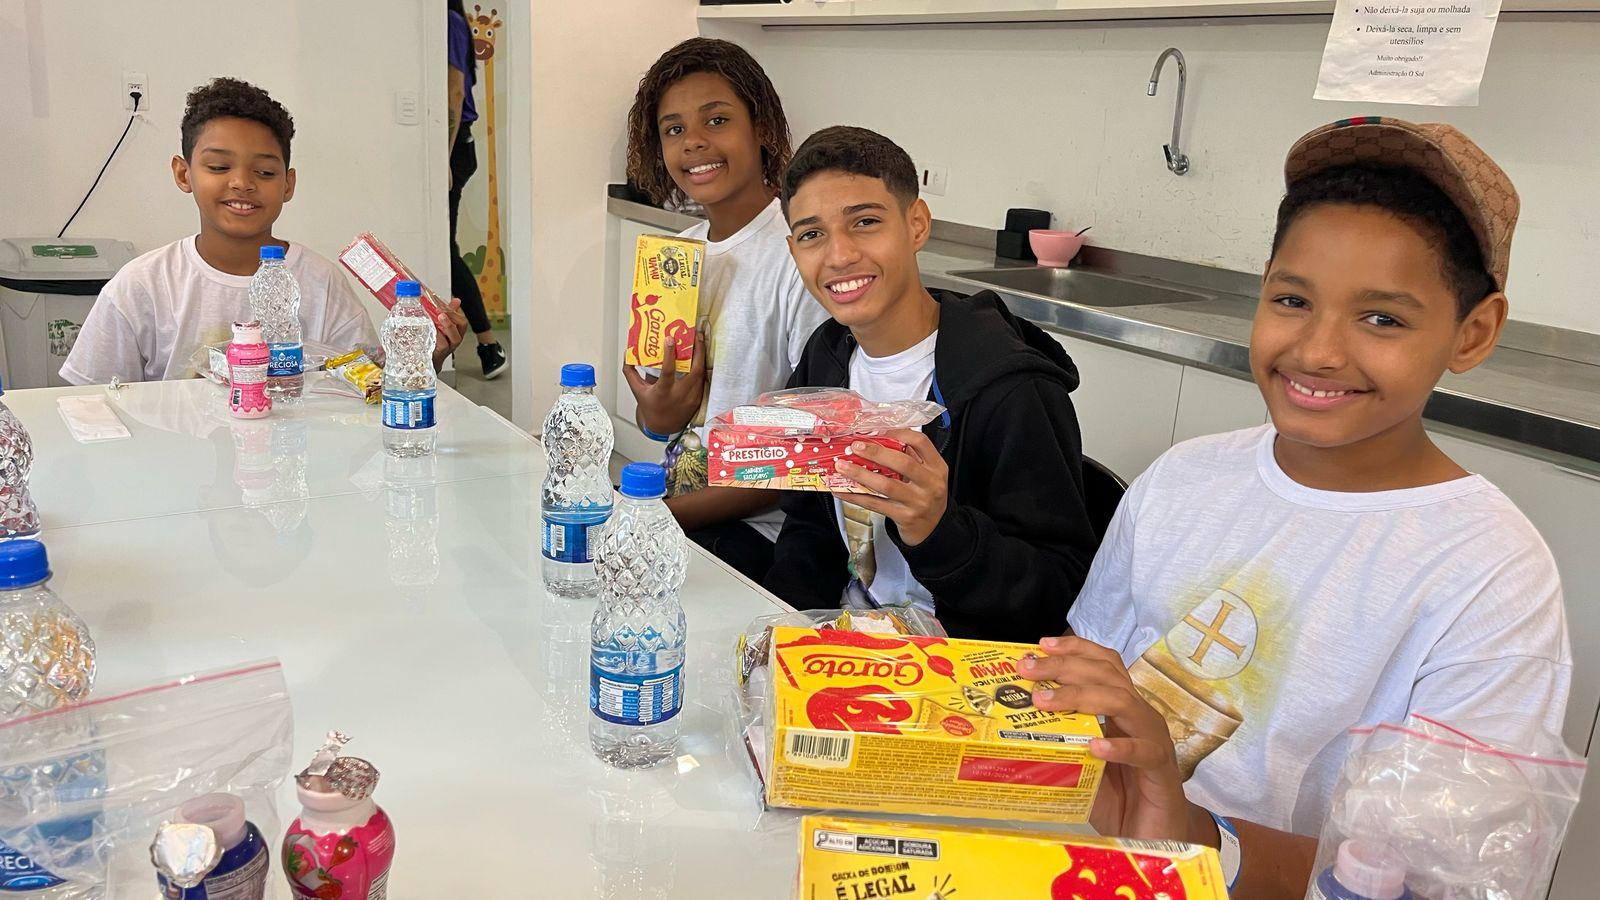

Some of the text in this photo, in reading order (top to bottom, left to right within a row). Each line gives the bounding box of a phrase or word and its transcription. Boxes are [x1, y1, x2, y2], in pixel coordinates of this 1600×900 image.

[1363, 6, 1378, 14] Não
[1379, 5, 1408, 14] deixá-la
[1410, 6, 1424, 15] suja
[1438, 5, 1471, 14] molhada
[1365, 25, 1396, 33] Deixá-la
[1416, 25, 1437, 35] limpa
[1389, 37, 1424, 45] utensílios
[1368, 69, 1408, 77] Administração
[647, 308, 666, 358] Garoto
[269, 361, 298, 369] RECIOSA
[729, 448, 784, 461] PRESTÍGIO
[804, 655, 924, 686] Garoto
[1000, 692, 1028, 702] TRUFA
[1005, 710, 1045, 723] LEGAL
[832, 871, 857, 882] CAIXA
[871, 861, 911, 876] BOMBOM
[851, 874, 916, 900] LEGAL
